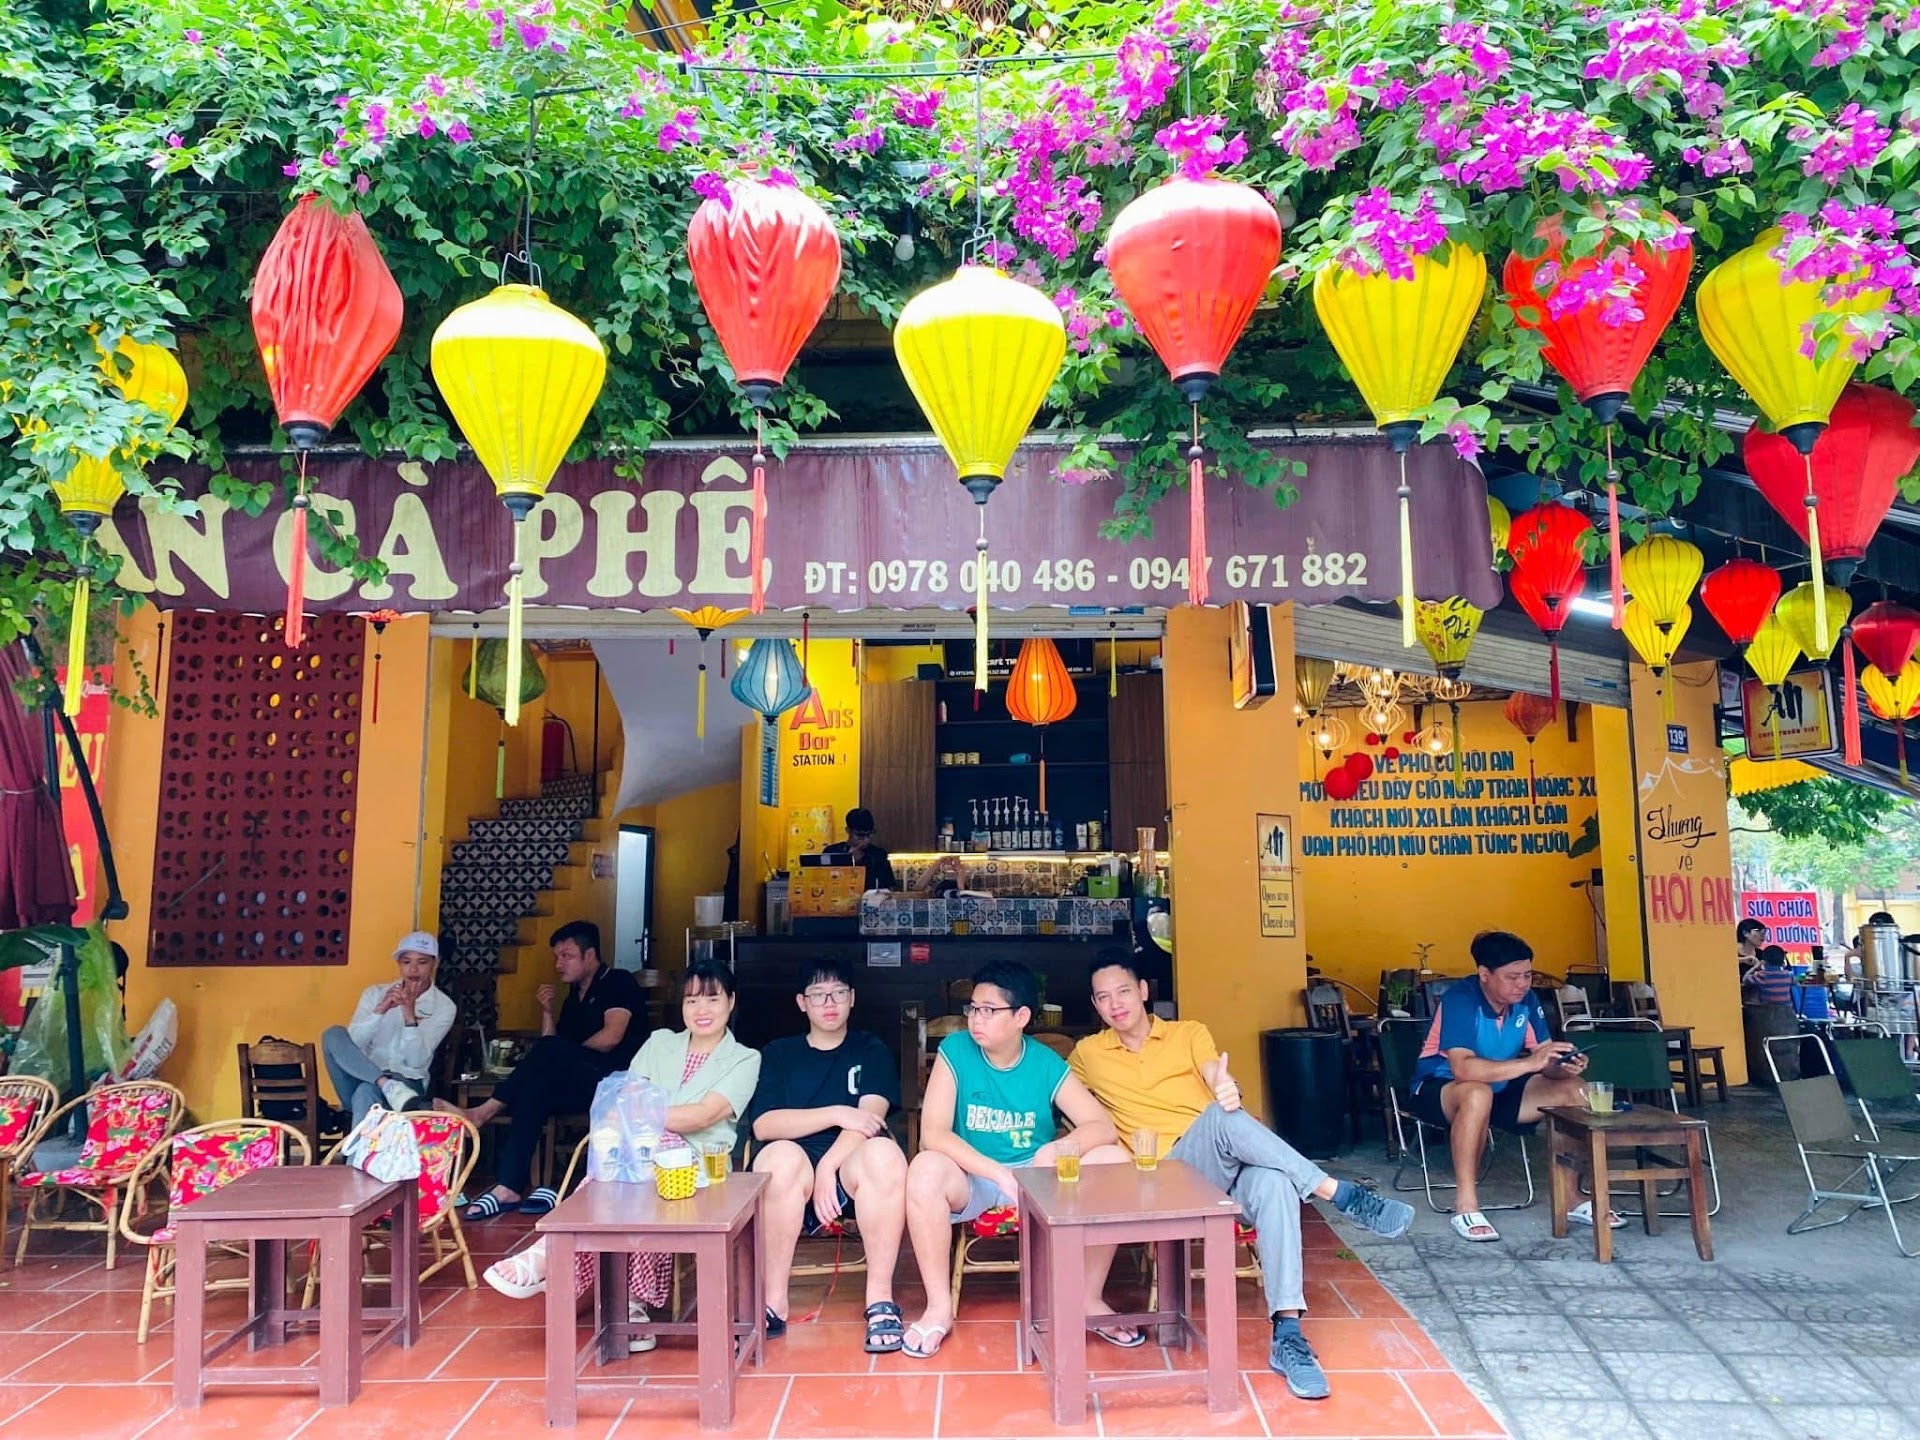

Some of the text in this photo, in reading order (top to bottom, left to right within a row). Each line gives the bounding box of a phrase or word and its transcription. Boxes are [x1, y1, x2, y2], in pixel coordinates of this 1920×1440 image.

[504, 455, 773, 598] PHÊ
[804, 561, 857, 594] ĐT:
[868, 560, 949, 594] 0978
[1032, 558, 1096, 592] 486
[1225, 555, 1289, 588] 671
[1302, 552, 1368, 587] 882
[799, 732, 836, 750] Bar
[793, 754, 835, 766] STATION
[1490, 751, 1515, 771] AN
[1415, 808, 1438, 828] XA
[1475, 802, 1531, 827] KHÁCH
[1701, 876, 1735, 925] AN
